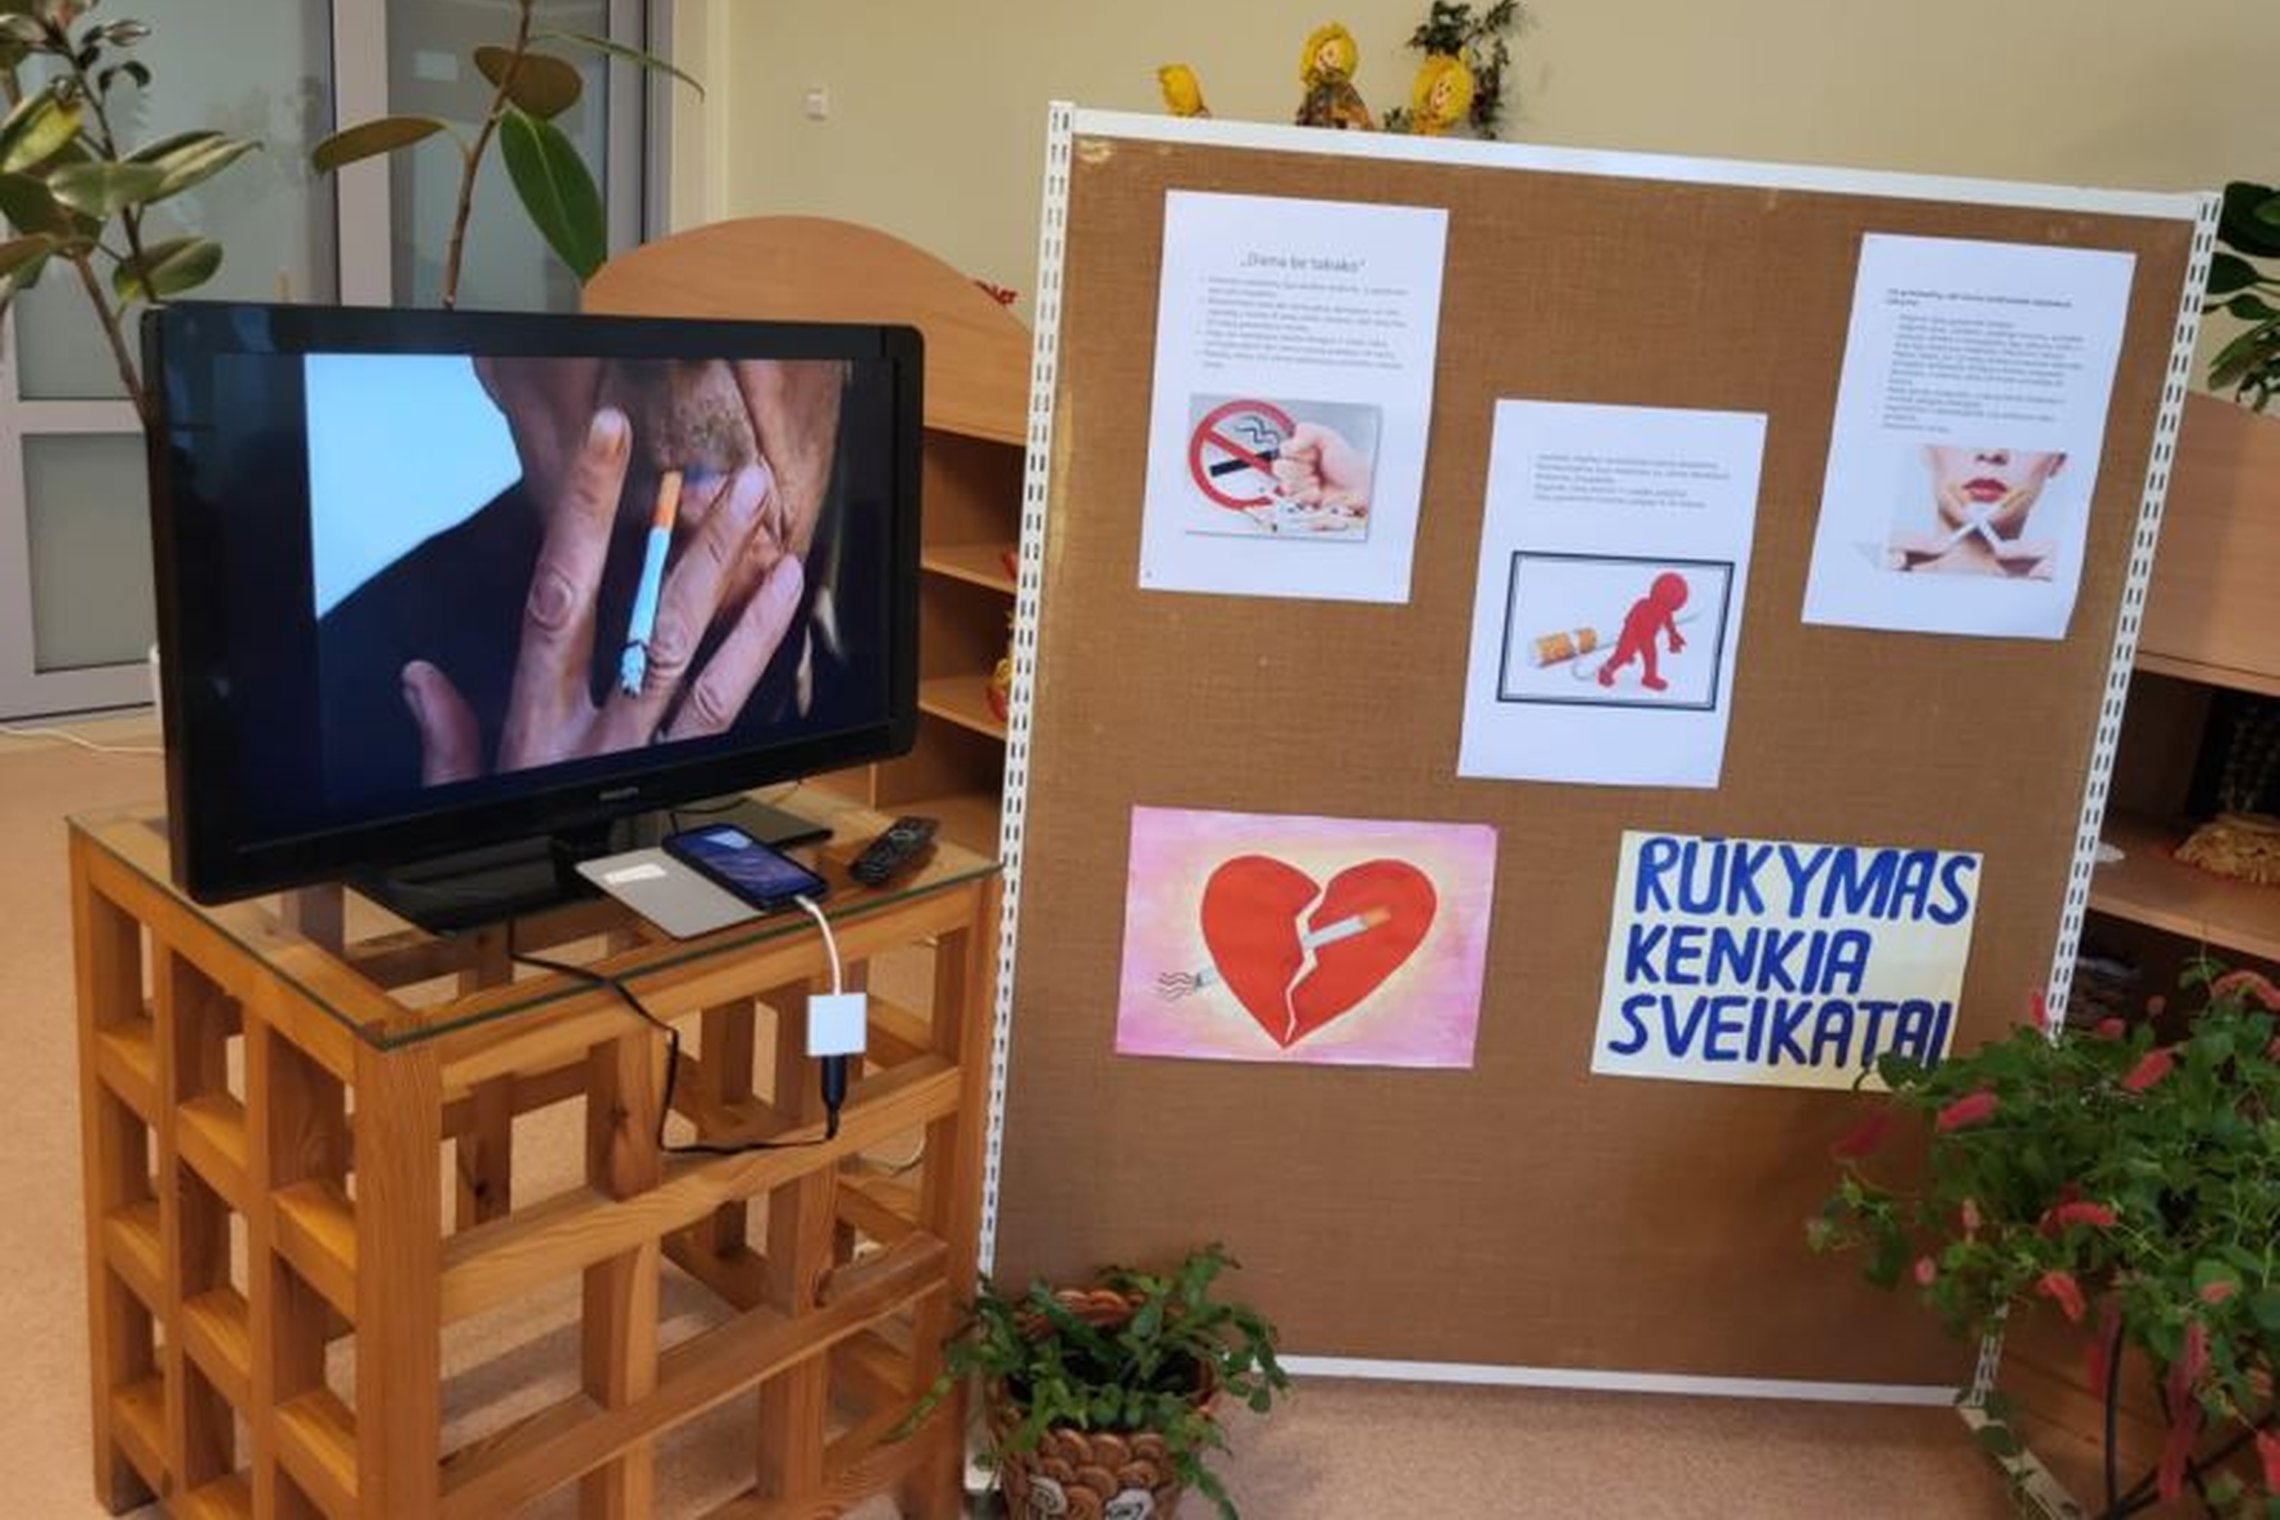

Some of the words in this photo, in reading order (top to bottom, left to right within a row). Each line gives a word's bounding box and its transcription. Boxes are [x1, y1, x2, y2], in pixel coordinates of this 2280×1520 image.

[1634, 835, 1977, 926] RŪKYMAS
[1625, 923, 1872, 995] KENKIA
[1608, 993, 1952, 1069] SVEIKATAI
